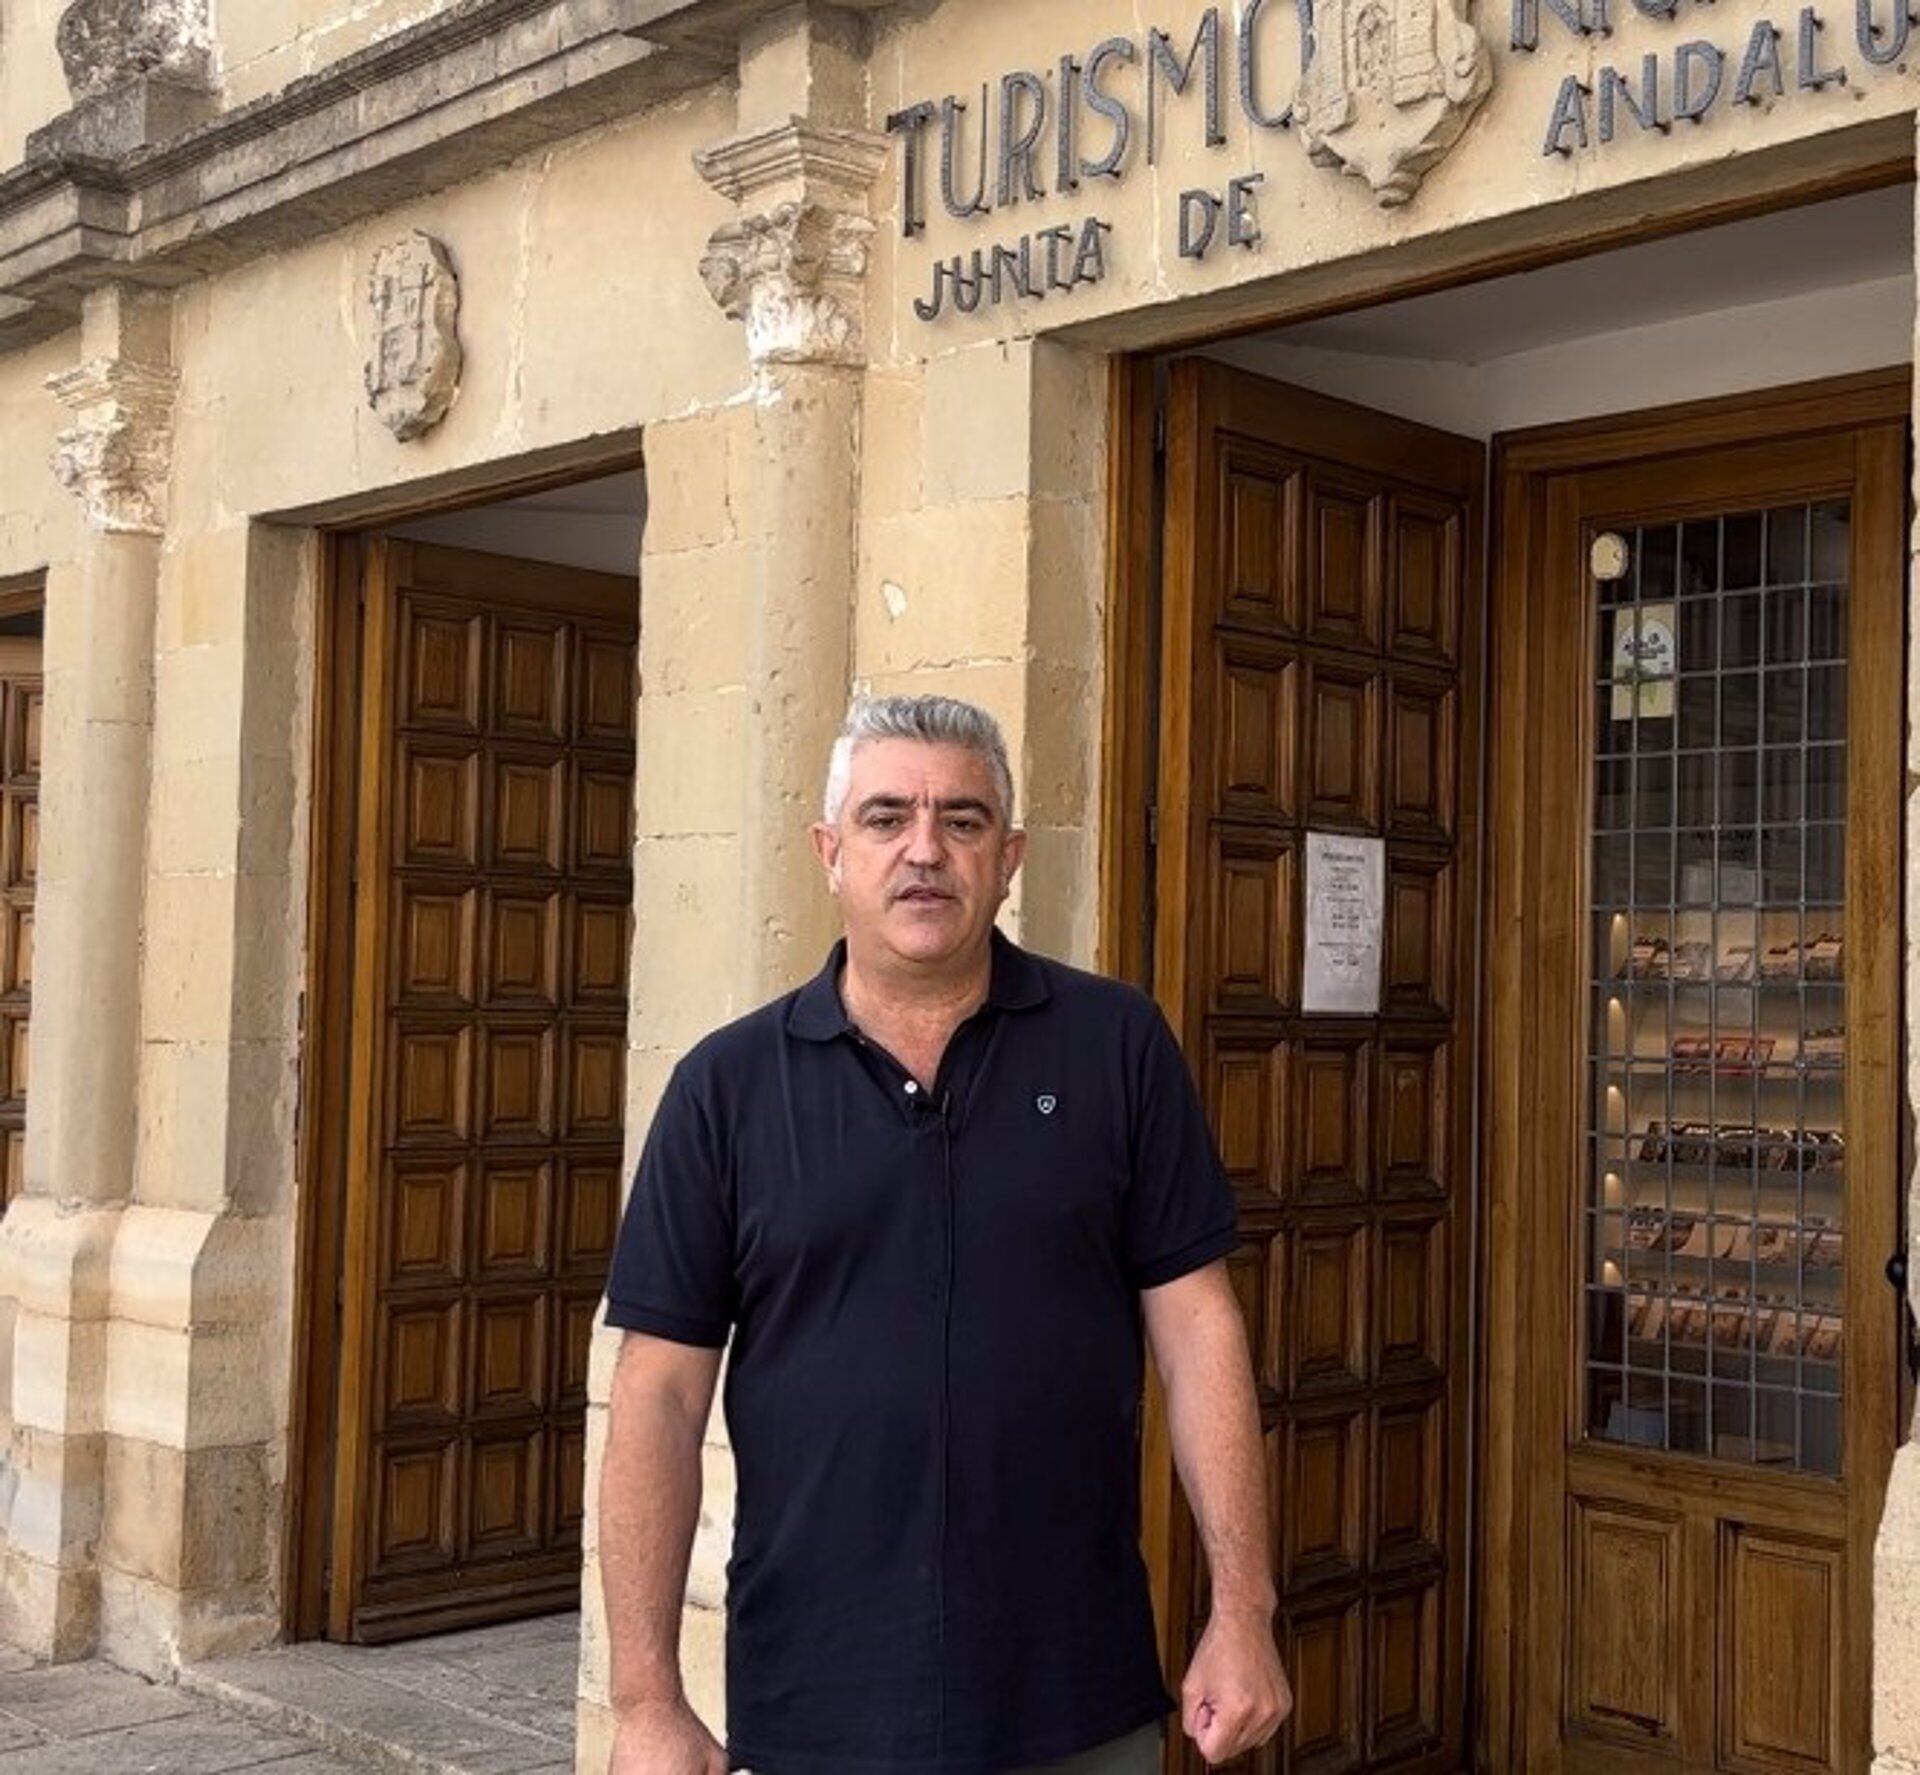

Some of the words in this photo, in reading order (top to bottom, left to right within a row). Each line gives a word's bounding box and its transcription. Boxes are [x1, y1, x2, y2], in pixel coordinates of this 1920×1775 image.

[886, 0, 1315, 237] TURISMO
[913, 216, 1109, 322] JUNTA
[1178, 172, 1264, 258] DE
[1543, 0, 1909, 156] ANDALU
